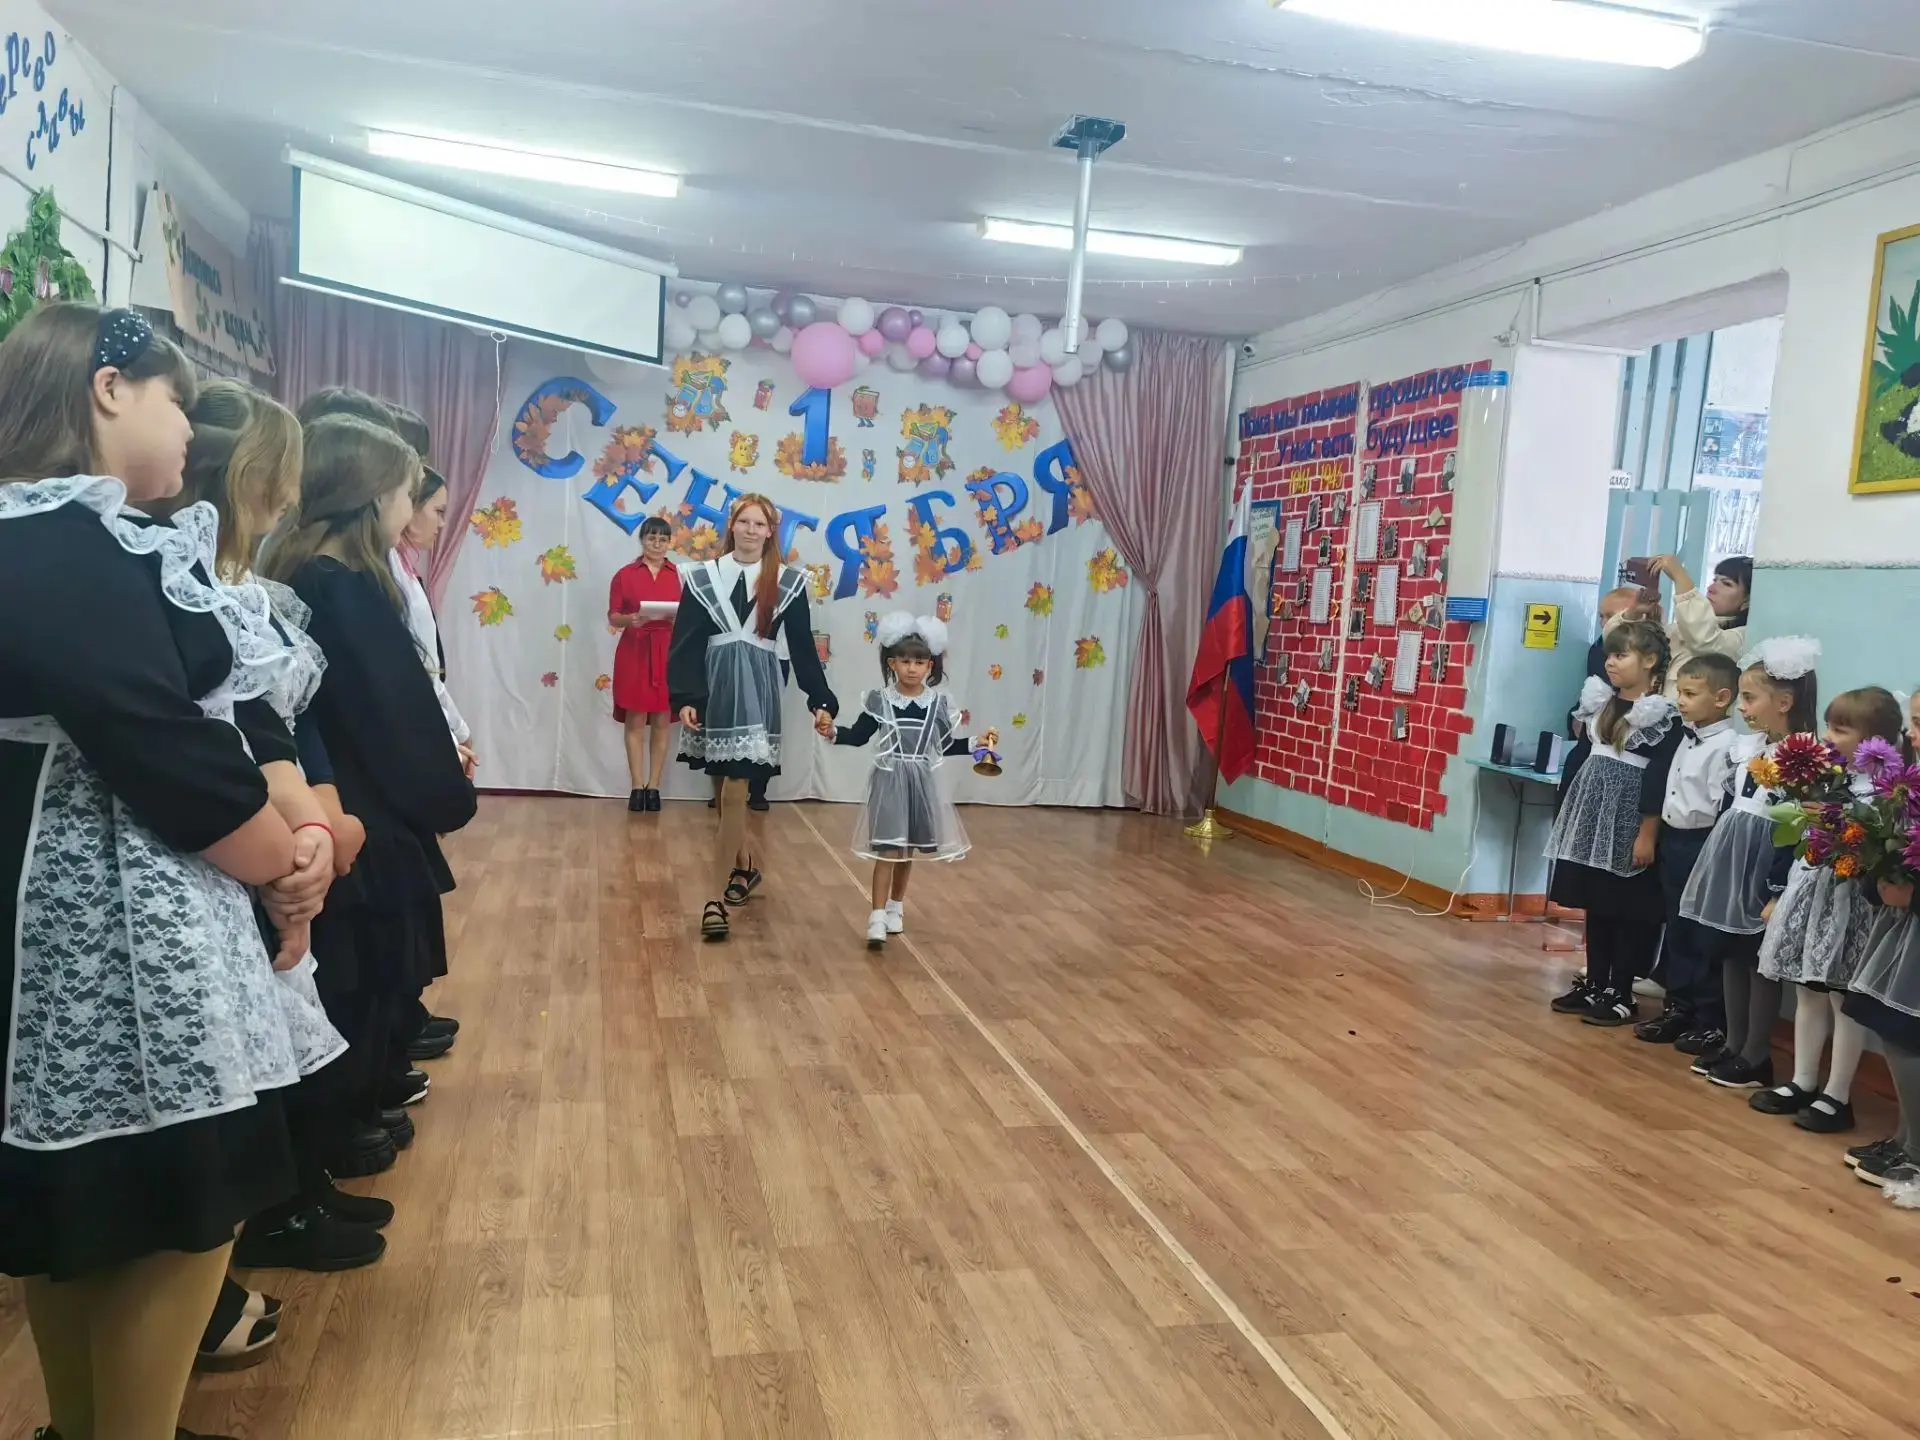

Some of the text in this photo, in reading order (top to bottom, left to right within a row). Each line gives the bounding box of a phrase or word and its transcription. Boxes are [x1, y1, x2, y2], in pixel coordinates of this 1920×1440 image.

[26, 87, 85, 171] славы
[789, 387, 832, 466] 1
[1239, 411, 1270, 439] Пока
[1274, 408, 1300, 432] мы
[1368, 366, 1467, 417] прошлое
[1291, 437, 1318, 463] нас
[1322, 433, 1355, 458] есть
[1366, 413, 1455, 459] будущее
